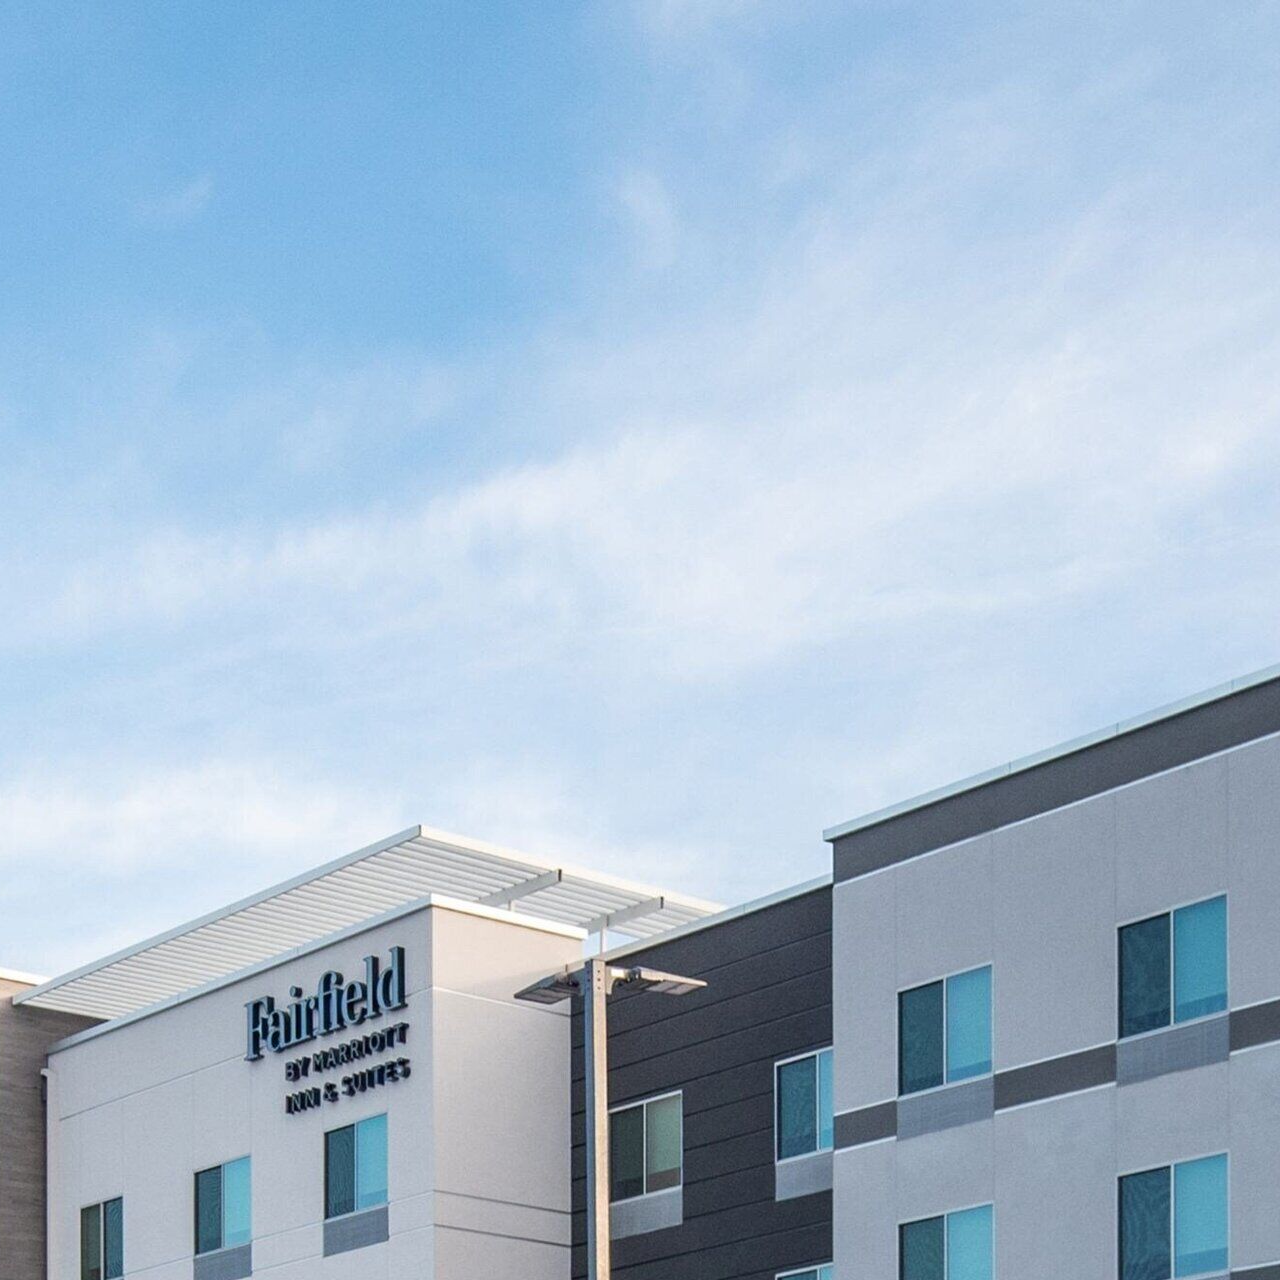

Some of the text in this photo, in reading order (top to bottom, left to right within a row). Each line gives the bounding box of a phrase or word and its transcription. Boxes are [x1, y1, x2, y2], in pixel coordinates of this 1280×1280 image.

[244, 946, 408, 1061] Fairfield
[285, 1022, 409, 1081] BY MARRIOTT
[285, 1057, 411, 1114] INN & SUITES
